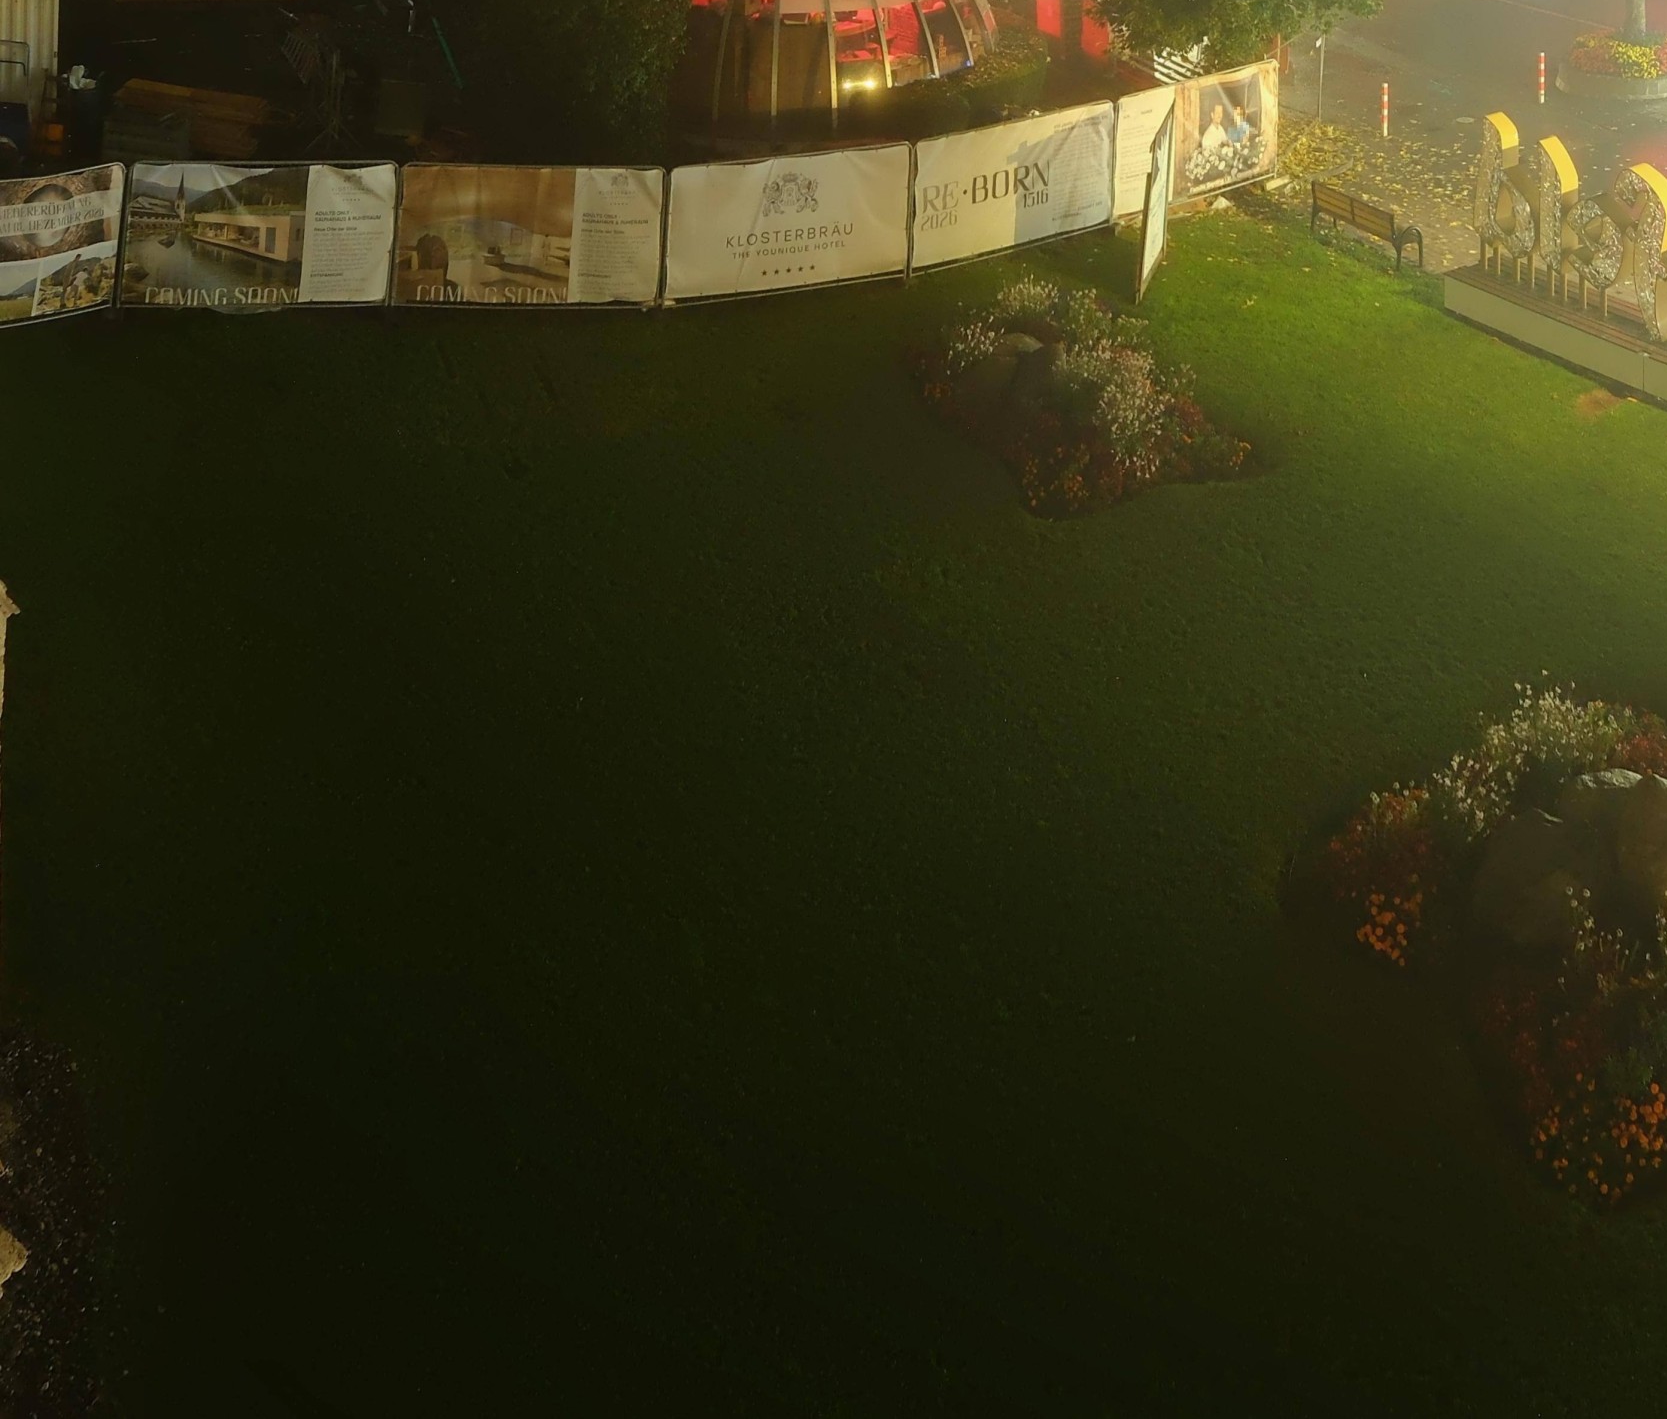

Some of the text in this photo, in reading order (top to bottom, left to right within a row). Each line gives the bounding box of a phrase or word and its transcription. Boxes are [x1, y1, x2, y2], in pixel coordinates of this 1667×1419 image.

[1023, 189, 1049, 209] 1516
[920, 210, 958, 232] 2026
[726, 222, 854, 248] KLOSTERBRÄU
[732, 239, 846, 260] THE YOUNIQUE HOTEL
